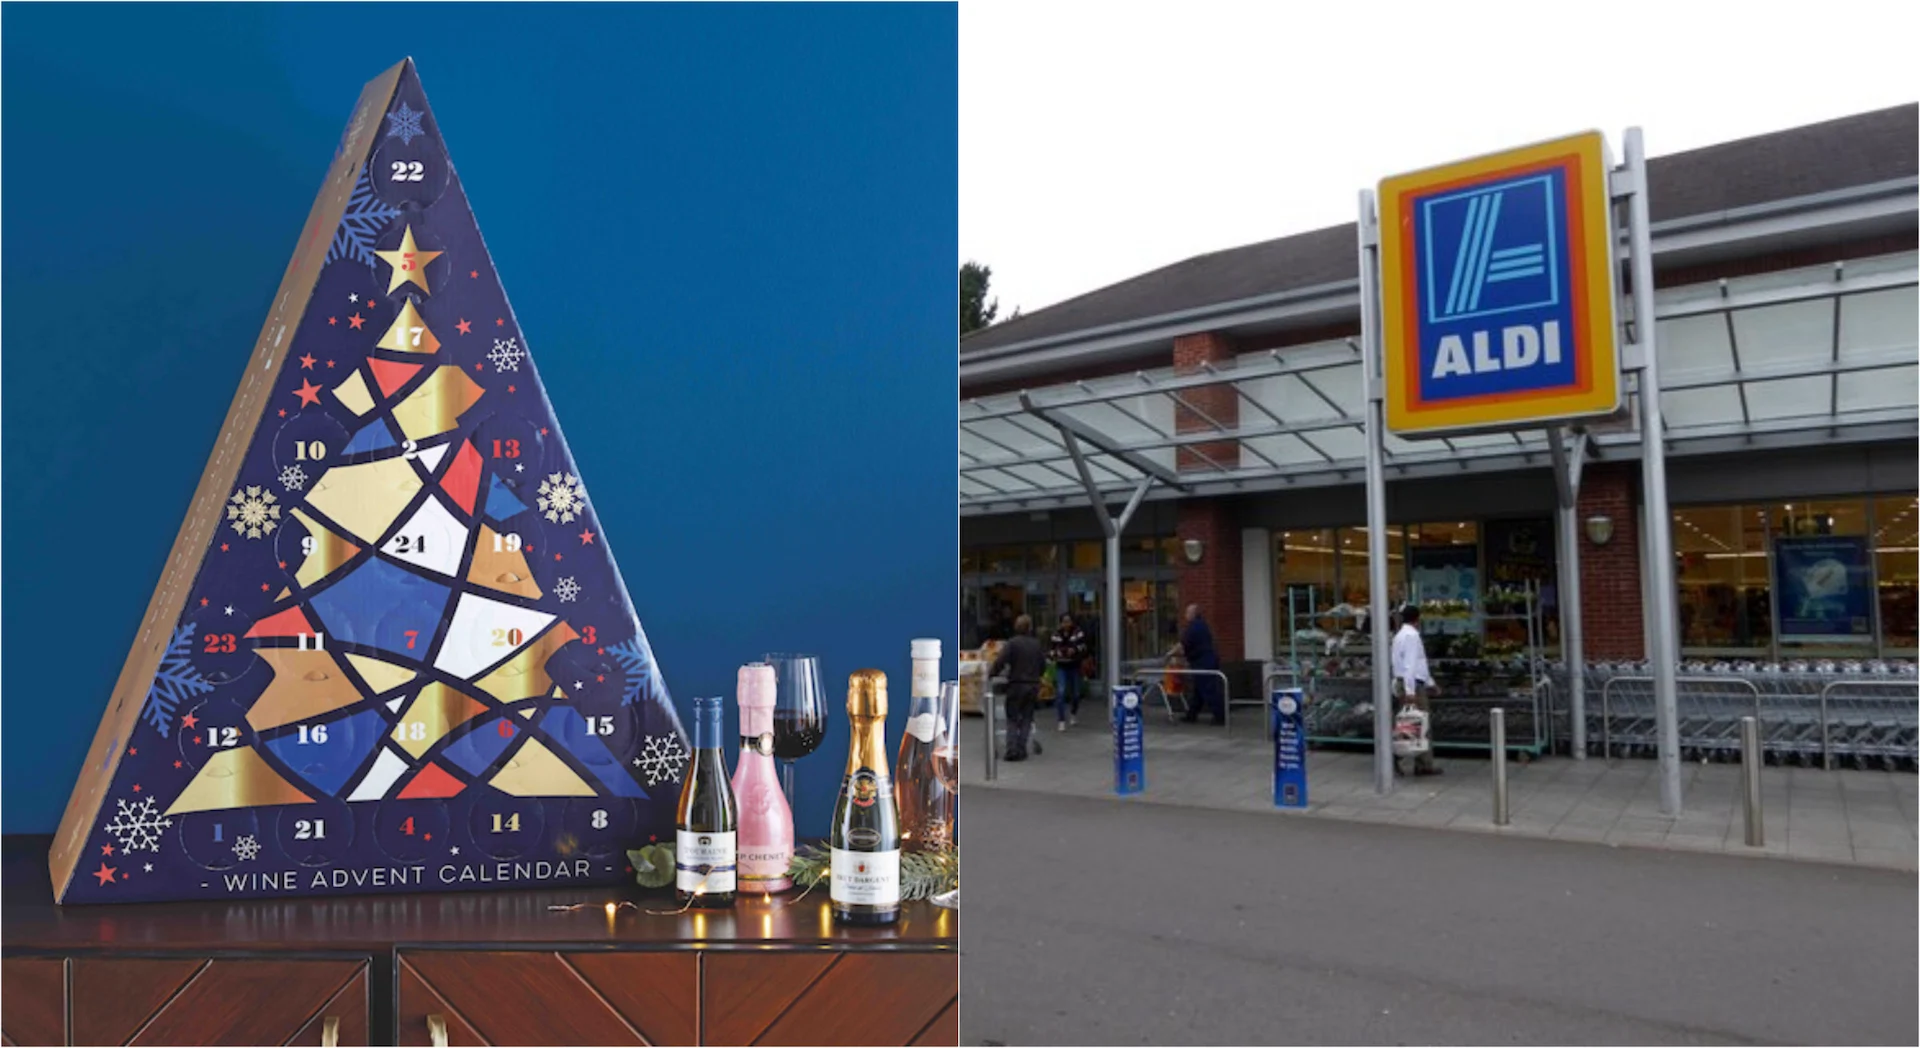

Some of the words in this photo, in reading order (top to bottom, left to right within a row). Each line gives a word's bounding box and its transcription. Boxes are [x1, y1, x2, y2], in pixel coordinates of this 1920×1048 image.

[391, 161, 425, 181] 22
[401, 252, 416, 271] 5
[396, 326, 424, 346] 17
[1432, 320, 1561, 379] ALDI
[294, 440, 326, 461] 10
[402, 440, 418, 459] 2
[491, 439, 521, 458] 13
[301, 536, 318, 555] 9
[394, 535, 426, 554] 24
[493, 534, 522, 553] 19
[203, 634, 237, 654] 23
[297, 632, 325, 651] 11
[403, 629, 419, 650] 7
[491, 629, 523, 647] 20
[581, 626, 596, 645] 3
[297, 725, 328, 744] 16
[396, 721, 427, 741] 18
[497, 720, 513, 739] 6
[585, 717, 614, 736] 15
[206, 727, 238, 747] 12
[399, 817, 415, 836] 4
[490, 814, 521, 834] 14
[591, 810, 608, 830] 8
[213, 824, 224, 843] 1
[294, 820, 326, 840] 21
[224, 871, 297, 892] WINE
[311, 866, 425, 888] ADVENT
[438, 860, 592, 884] CALENDAR
